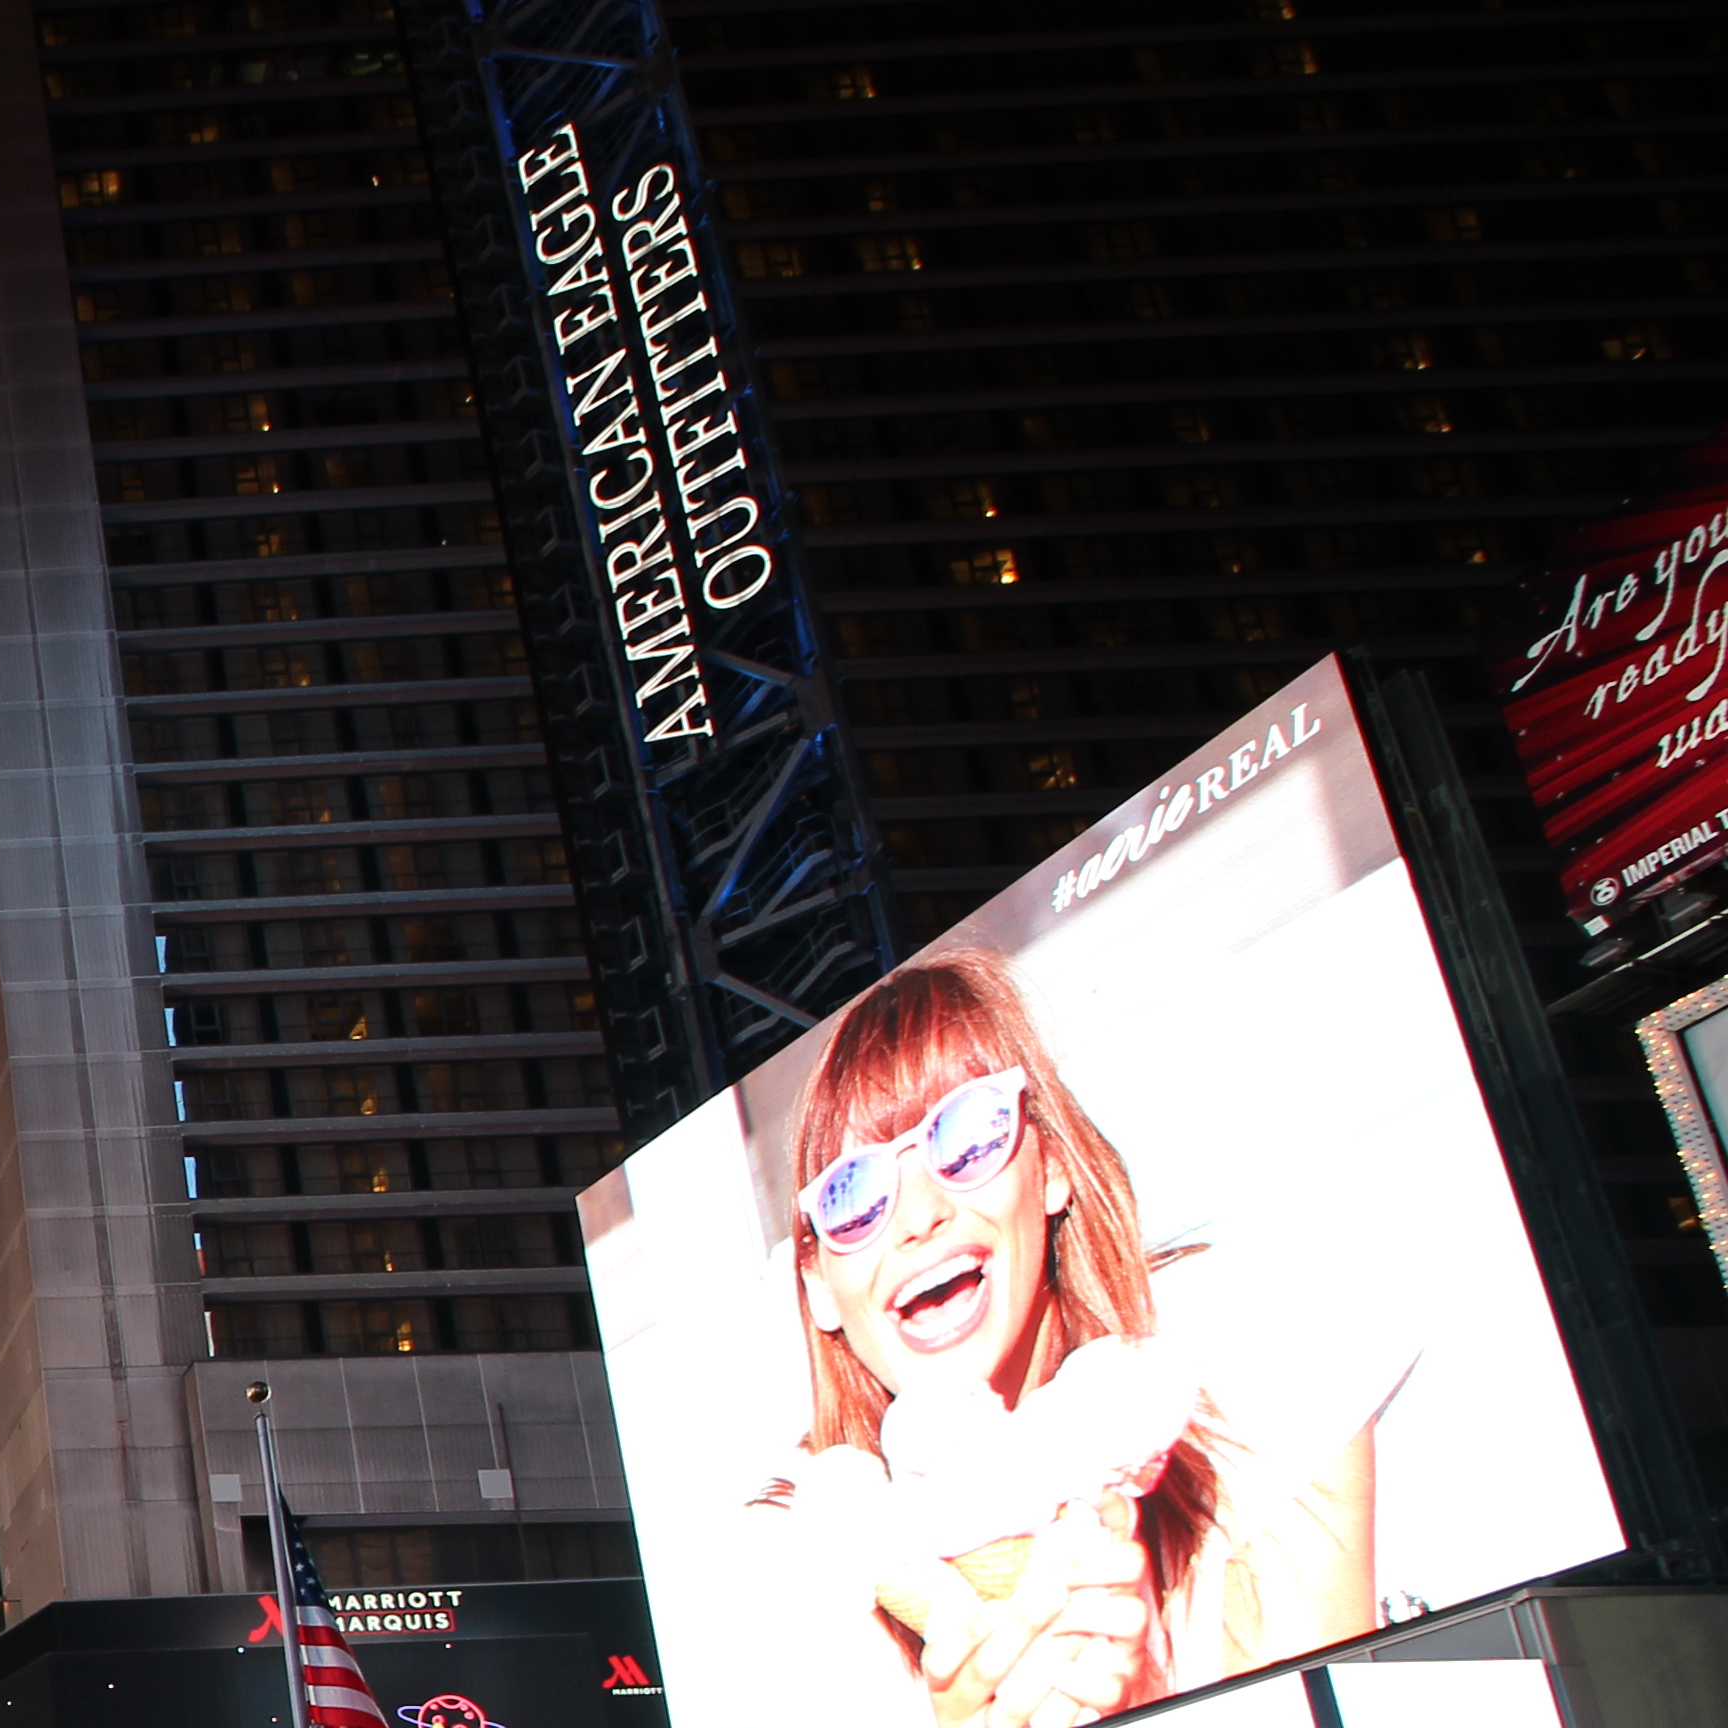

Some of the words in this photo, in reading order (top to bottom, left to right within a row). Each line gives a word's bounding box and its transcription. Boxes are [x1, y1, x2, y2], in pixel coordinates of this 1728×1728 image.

[517, 121, 620, 355] EAGLE
[612, 163, 773, 610] OUTFITTERS
[567, 347, 715, 743] AMERICAN
[1512, 574, 1639, 692] Are
[1621, 823, 1713, 888] IMPERIAL
[328, 1589, 463, 1611] MARRIOTT
